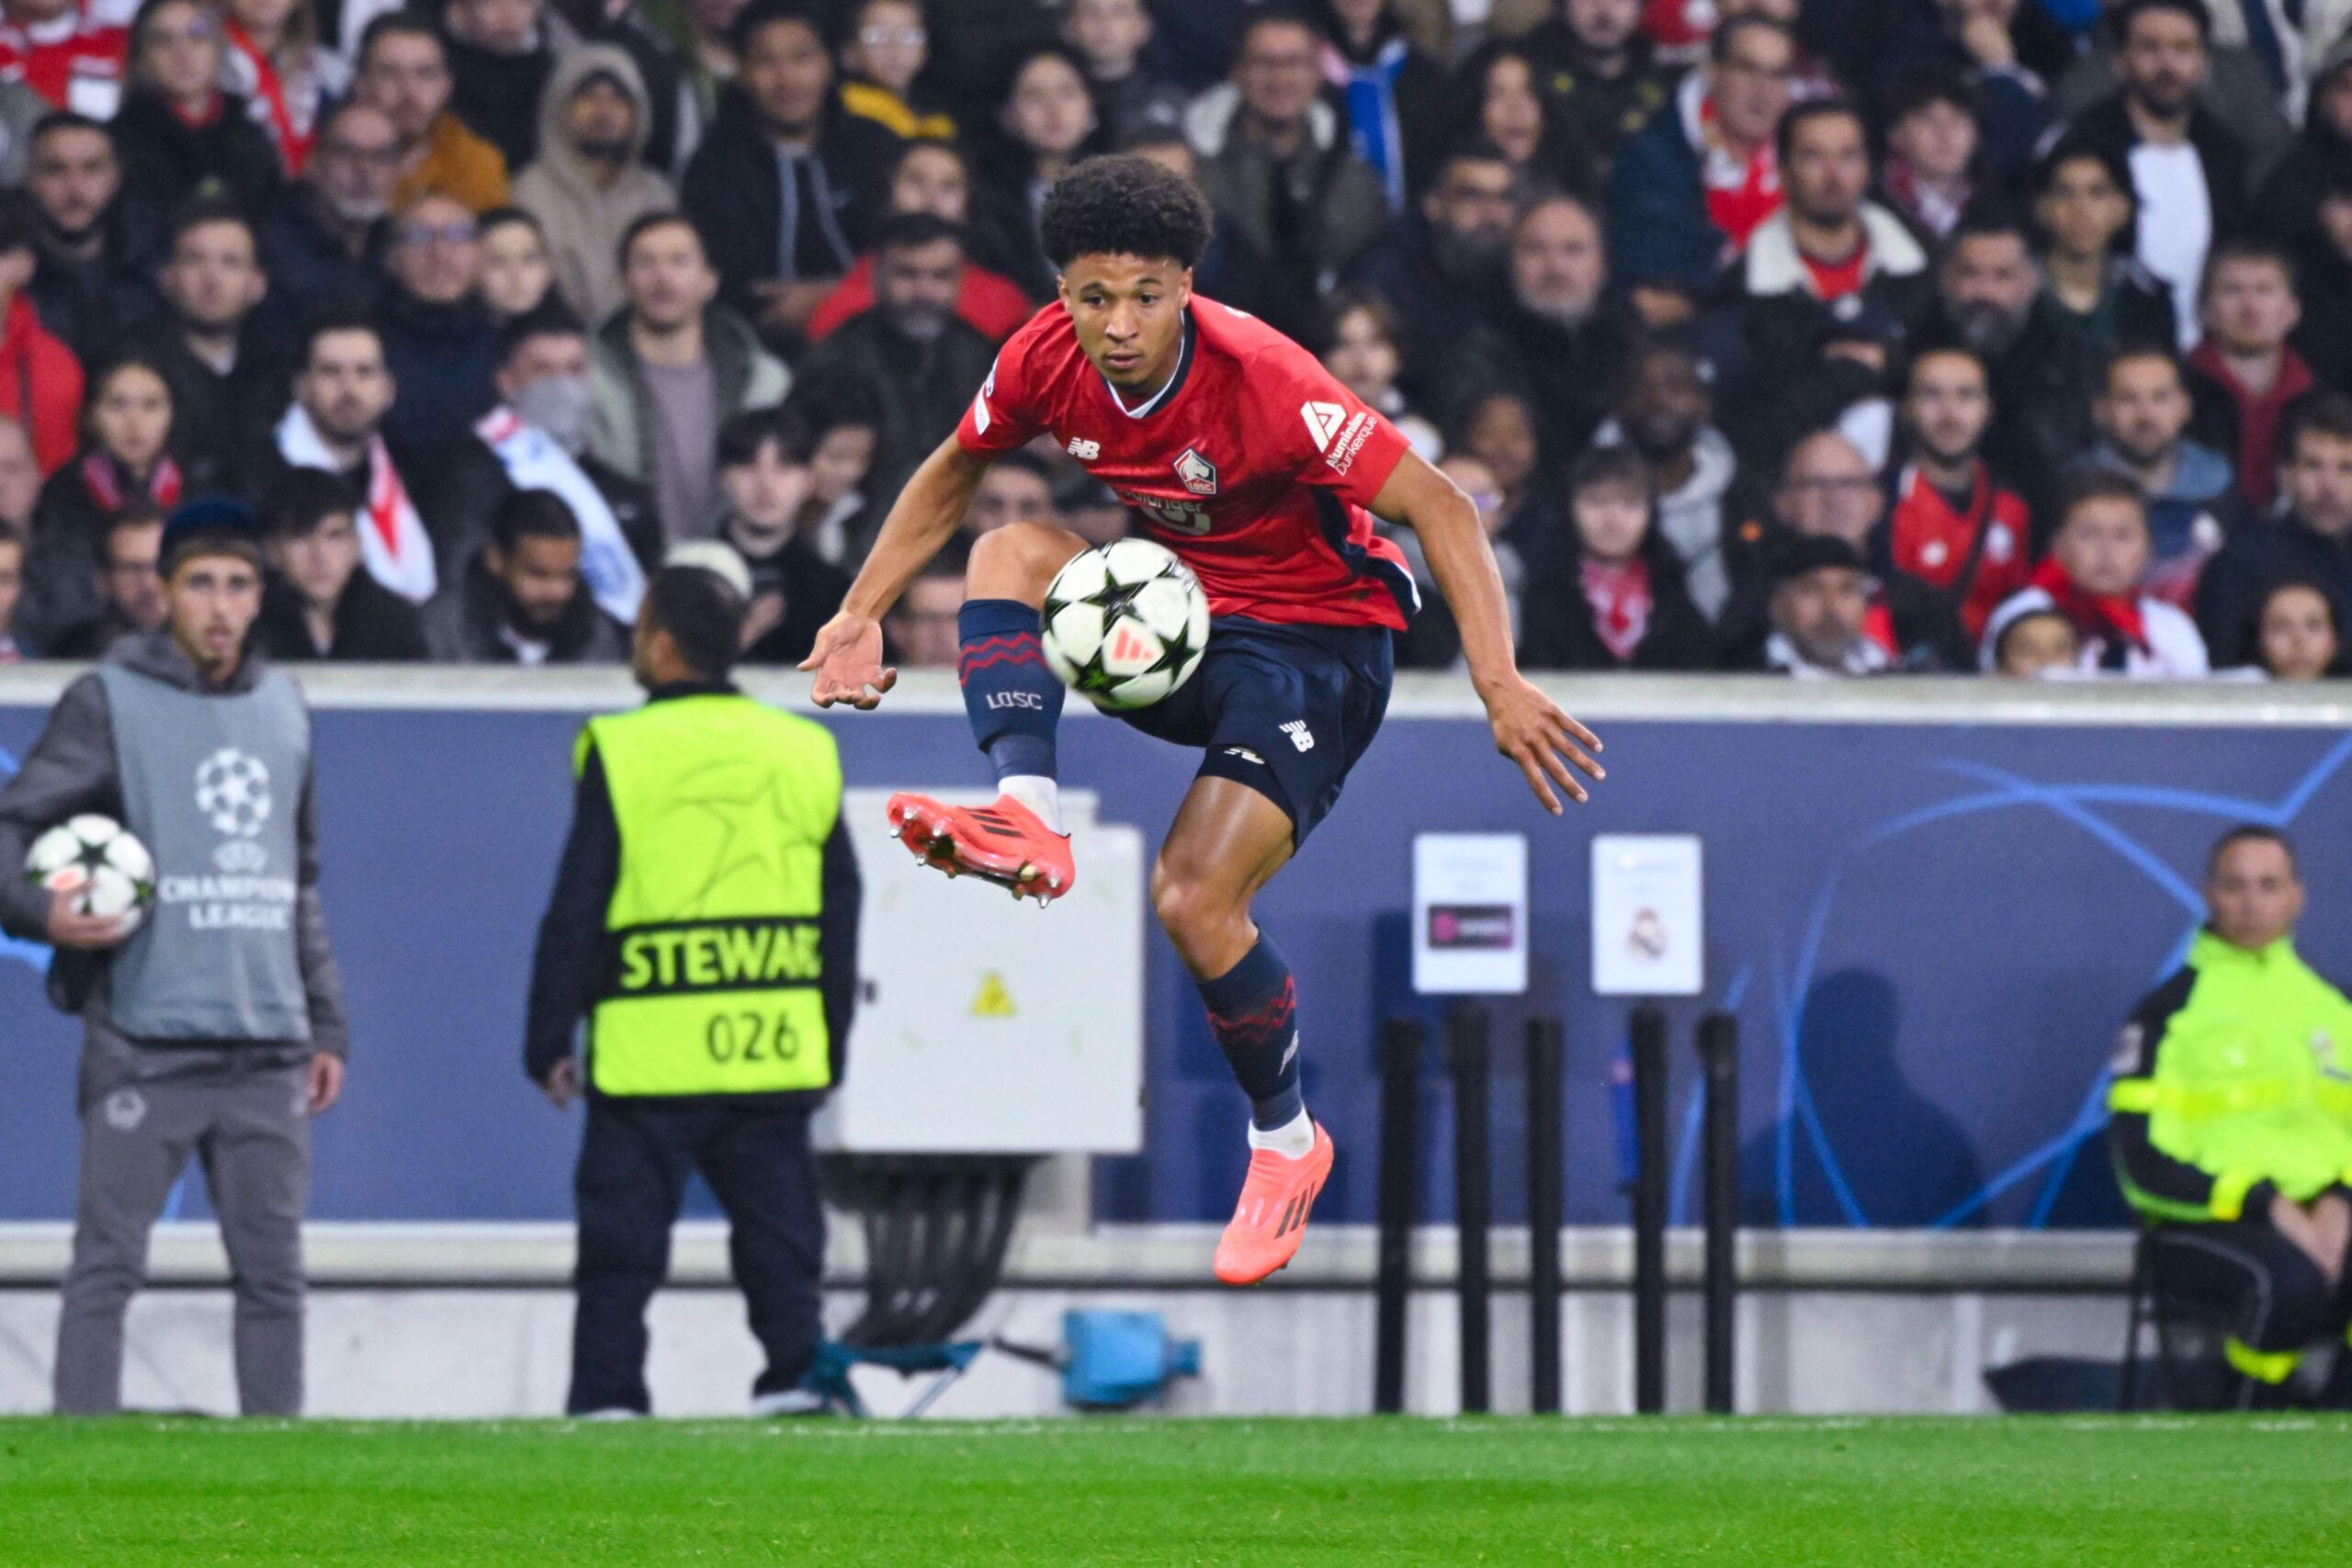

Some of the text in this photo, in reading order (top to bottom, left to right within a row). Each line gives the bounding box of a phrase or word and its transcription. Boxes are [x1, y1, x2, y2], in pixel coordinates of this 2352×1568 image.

[1325, 412, 1367, 468] Aluminium
[1335, 416, 1378, 477] Dunkerque
[986, 691, 1043, 710] LOSC
[706, 1012, 799, 1063] 026
